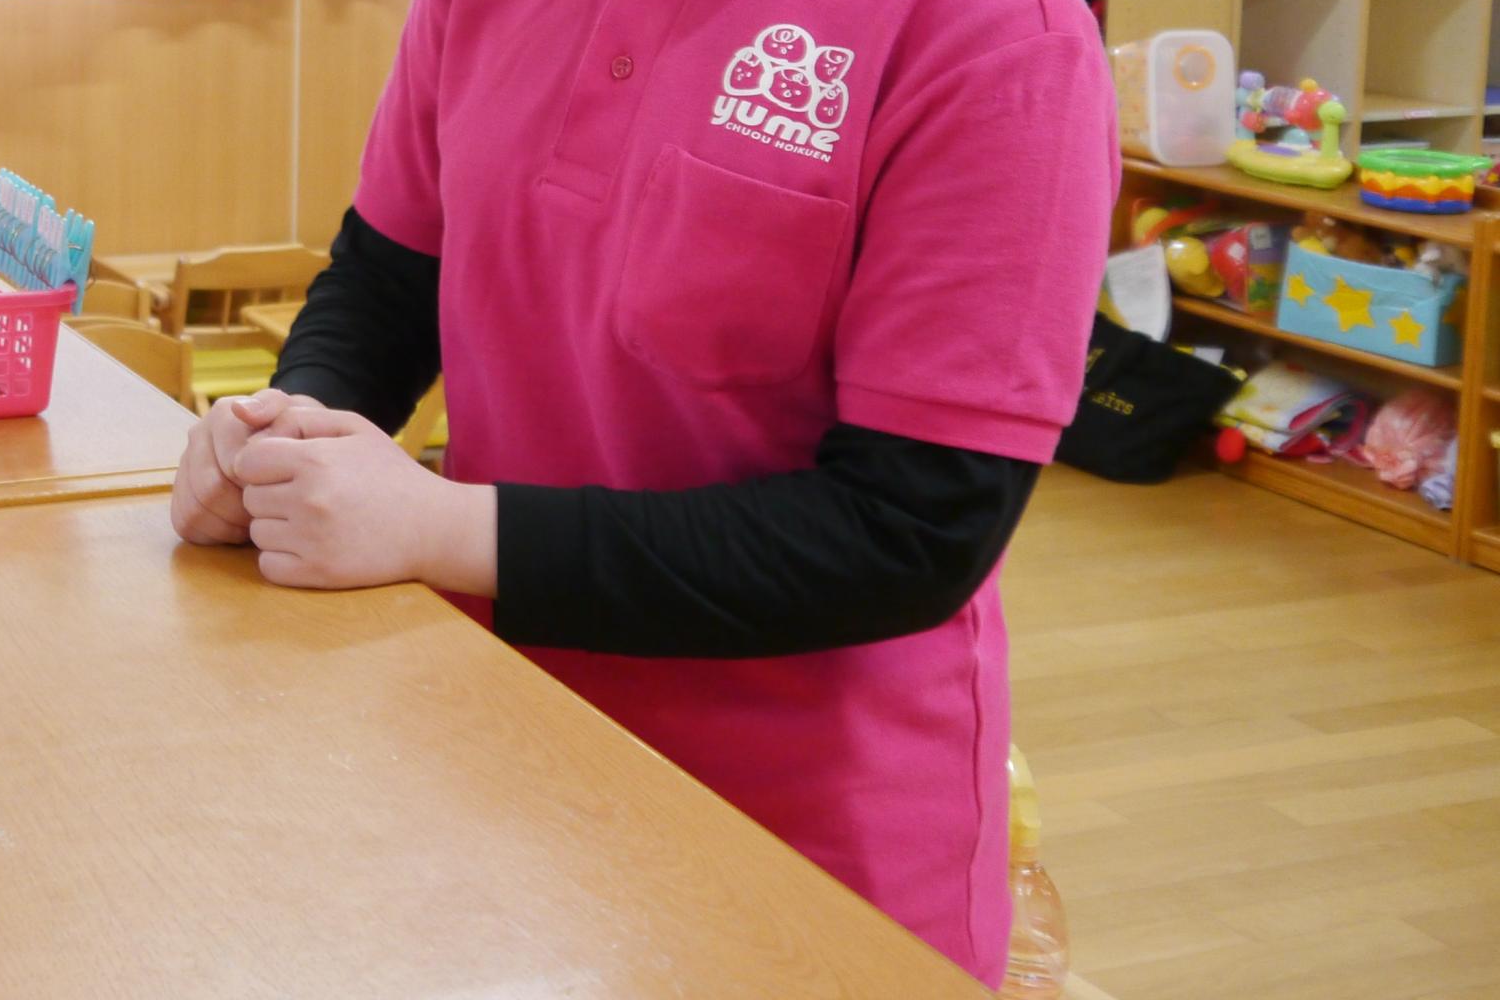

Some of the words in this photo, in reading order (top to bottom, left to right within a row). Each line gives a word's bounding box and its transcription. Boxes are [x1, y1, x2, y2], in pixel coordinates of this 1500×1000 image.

[710, 95, 840, 153] yume
[725, 121, 771, 144] CHUOU
[774, 140, 832, 163] HOIKUEN
